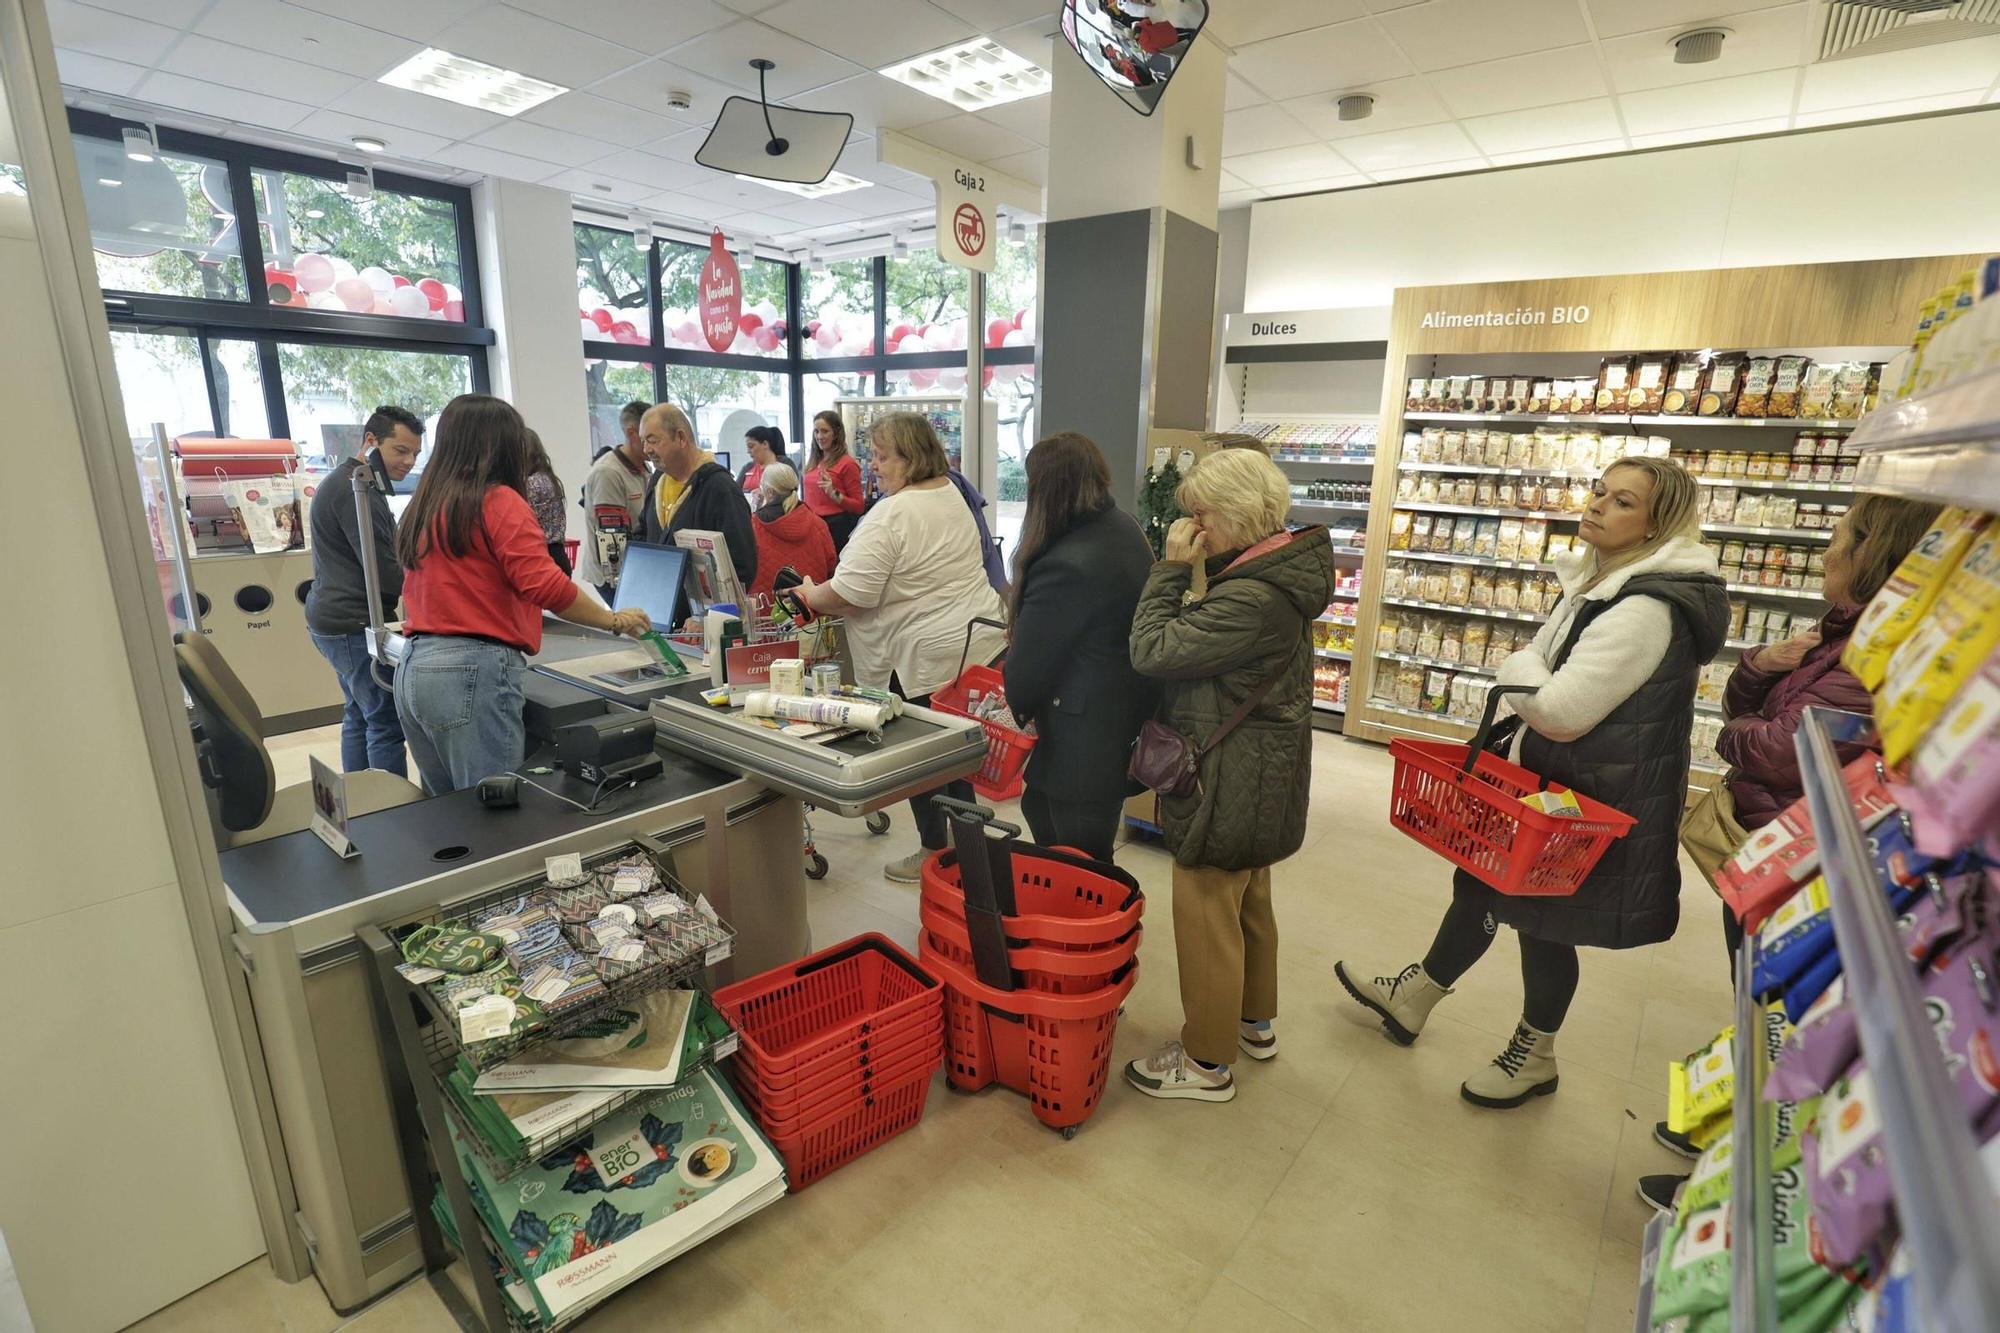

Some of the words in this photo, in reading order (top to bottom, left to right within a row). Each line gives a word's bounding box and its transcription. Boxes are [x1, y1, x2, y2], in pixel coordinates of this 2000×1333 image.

[954, 168, 976, 191] Caja
[978, 177, 985, 192] 2
[705, 277, 734, 303] Navidad
[1251, 321, 1297, 337] Dulces
[1420, 309, 1545, 330] Alimentación
[1551, 305, 1590, 325] BIO
[247, 620, 271, 630] Papel
[753, 652, 771, 663] Caja
[666, 1084, 698, 1104] mag.
[599, 1140, 631, 1162] ener
[1772, 1167, 1799, 1244] Ricola
[556, 1252, 617, 1288] ROSSMANN
